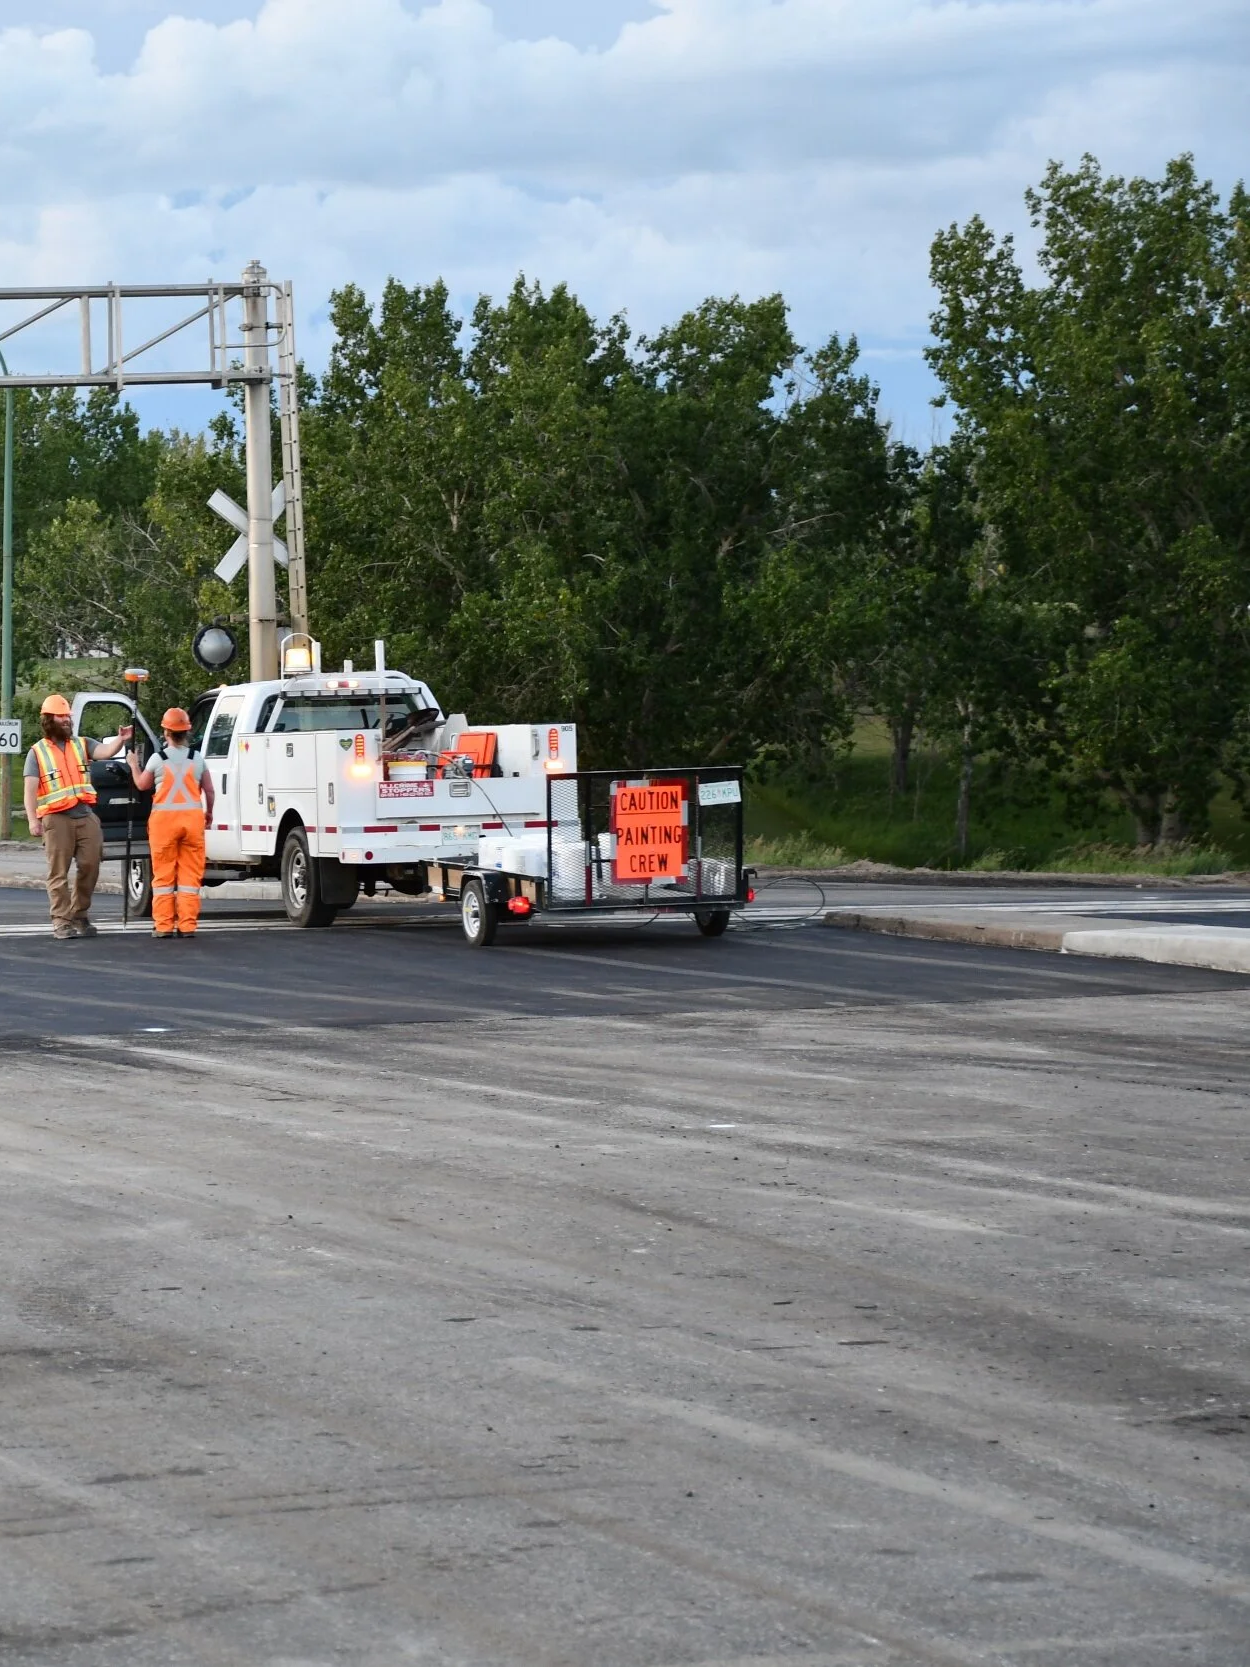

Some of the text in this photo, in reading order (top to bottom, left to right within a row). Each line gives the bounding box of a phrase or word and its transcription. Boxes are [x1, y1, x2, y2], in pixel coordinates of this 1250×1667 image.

[620, 790, 679, 811] CAUTION
[700, 790, 717, 800] 226
[616, 825, 682, 846] PAINTING
[629, 853, 669, 873] CREW
